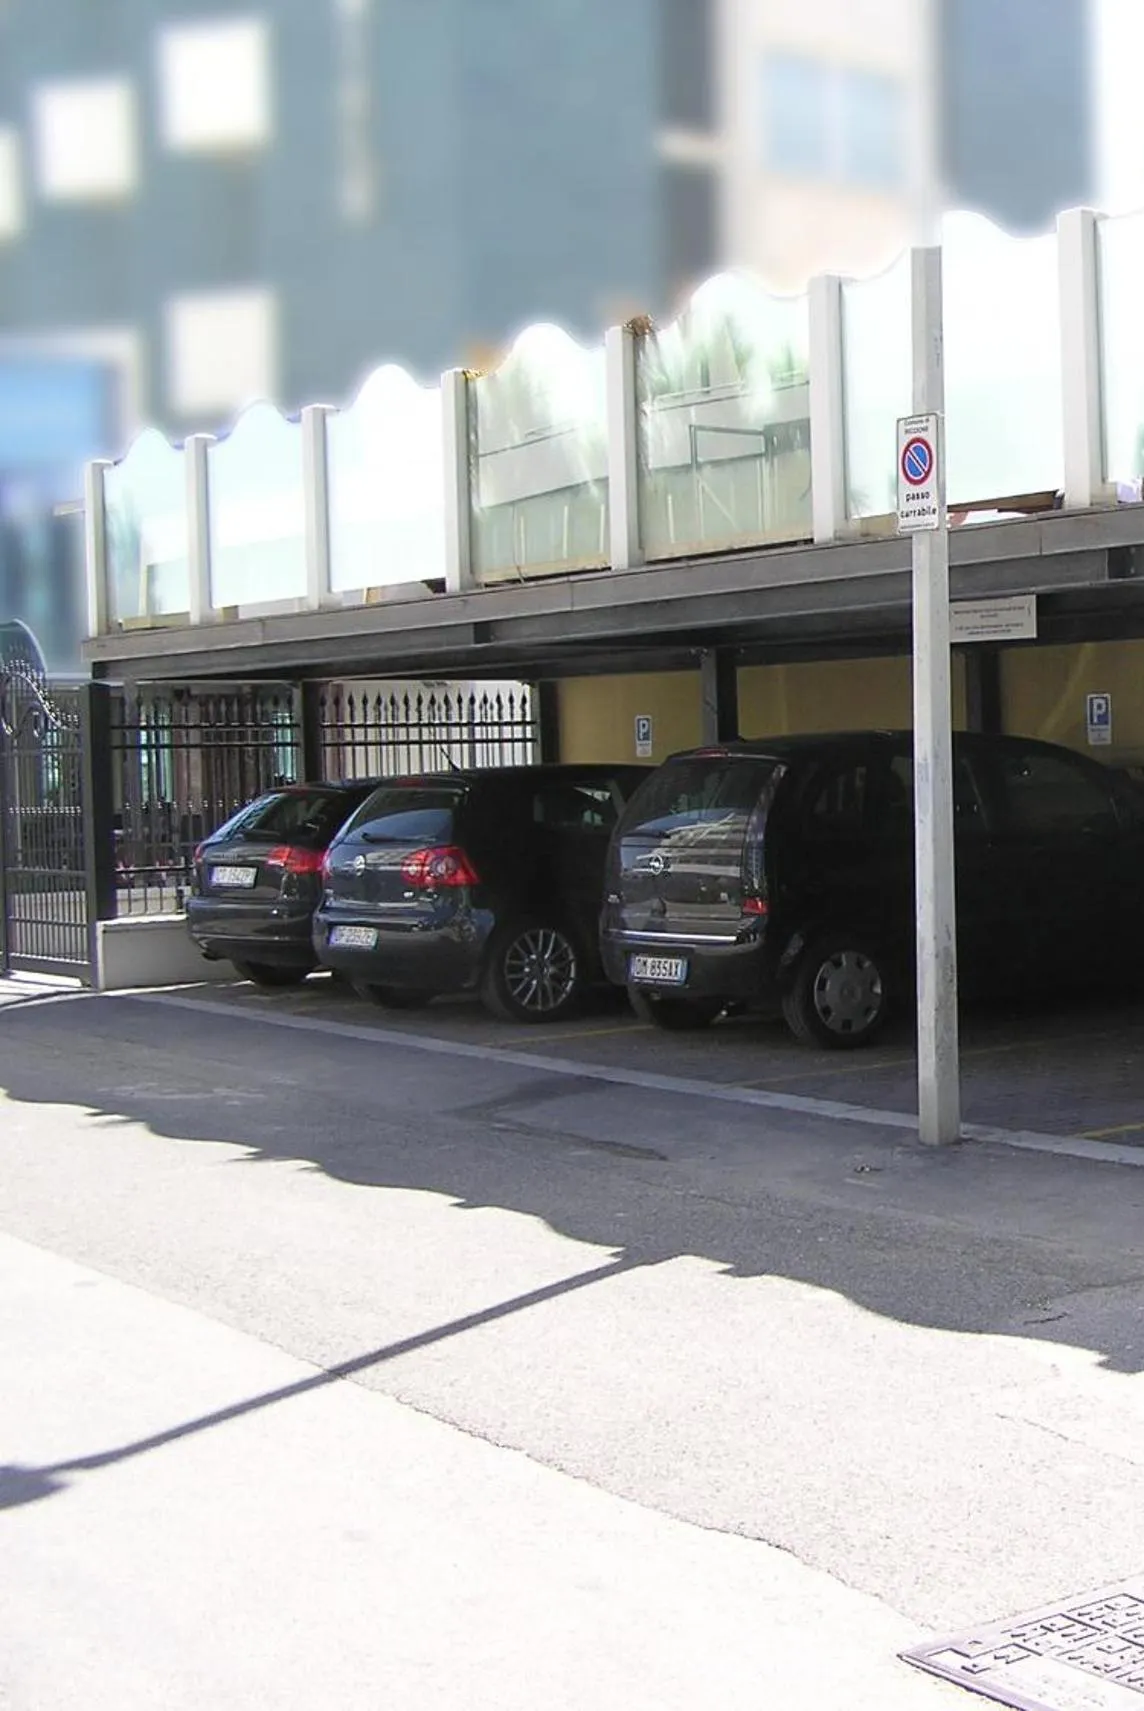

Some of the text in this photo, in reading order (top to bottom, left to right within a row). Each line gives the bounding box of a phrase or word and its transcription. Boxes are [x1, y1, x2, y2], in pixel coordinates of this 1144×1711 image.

[905, 491, 930, 502] passo
[901, 506, 937, 519] carrabile
[1093, 697, 1107, 724] P
[639, 719, 649, 741] P
